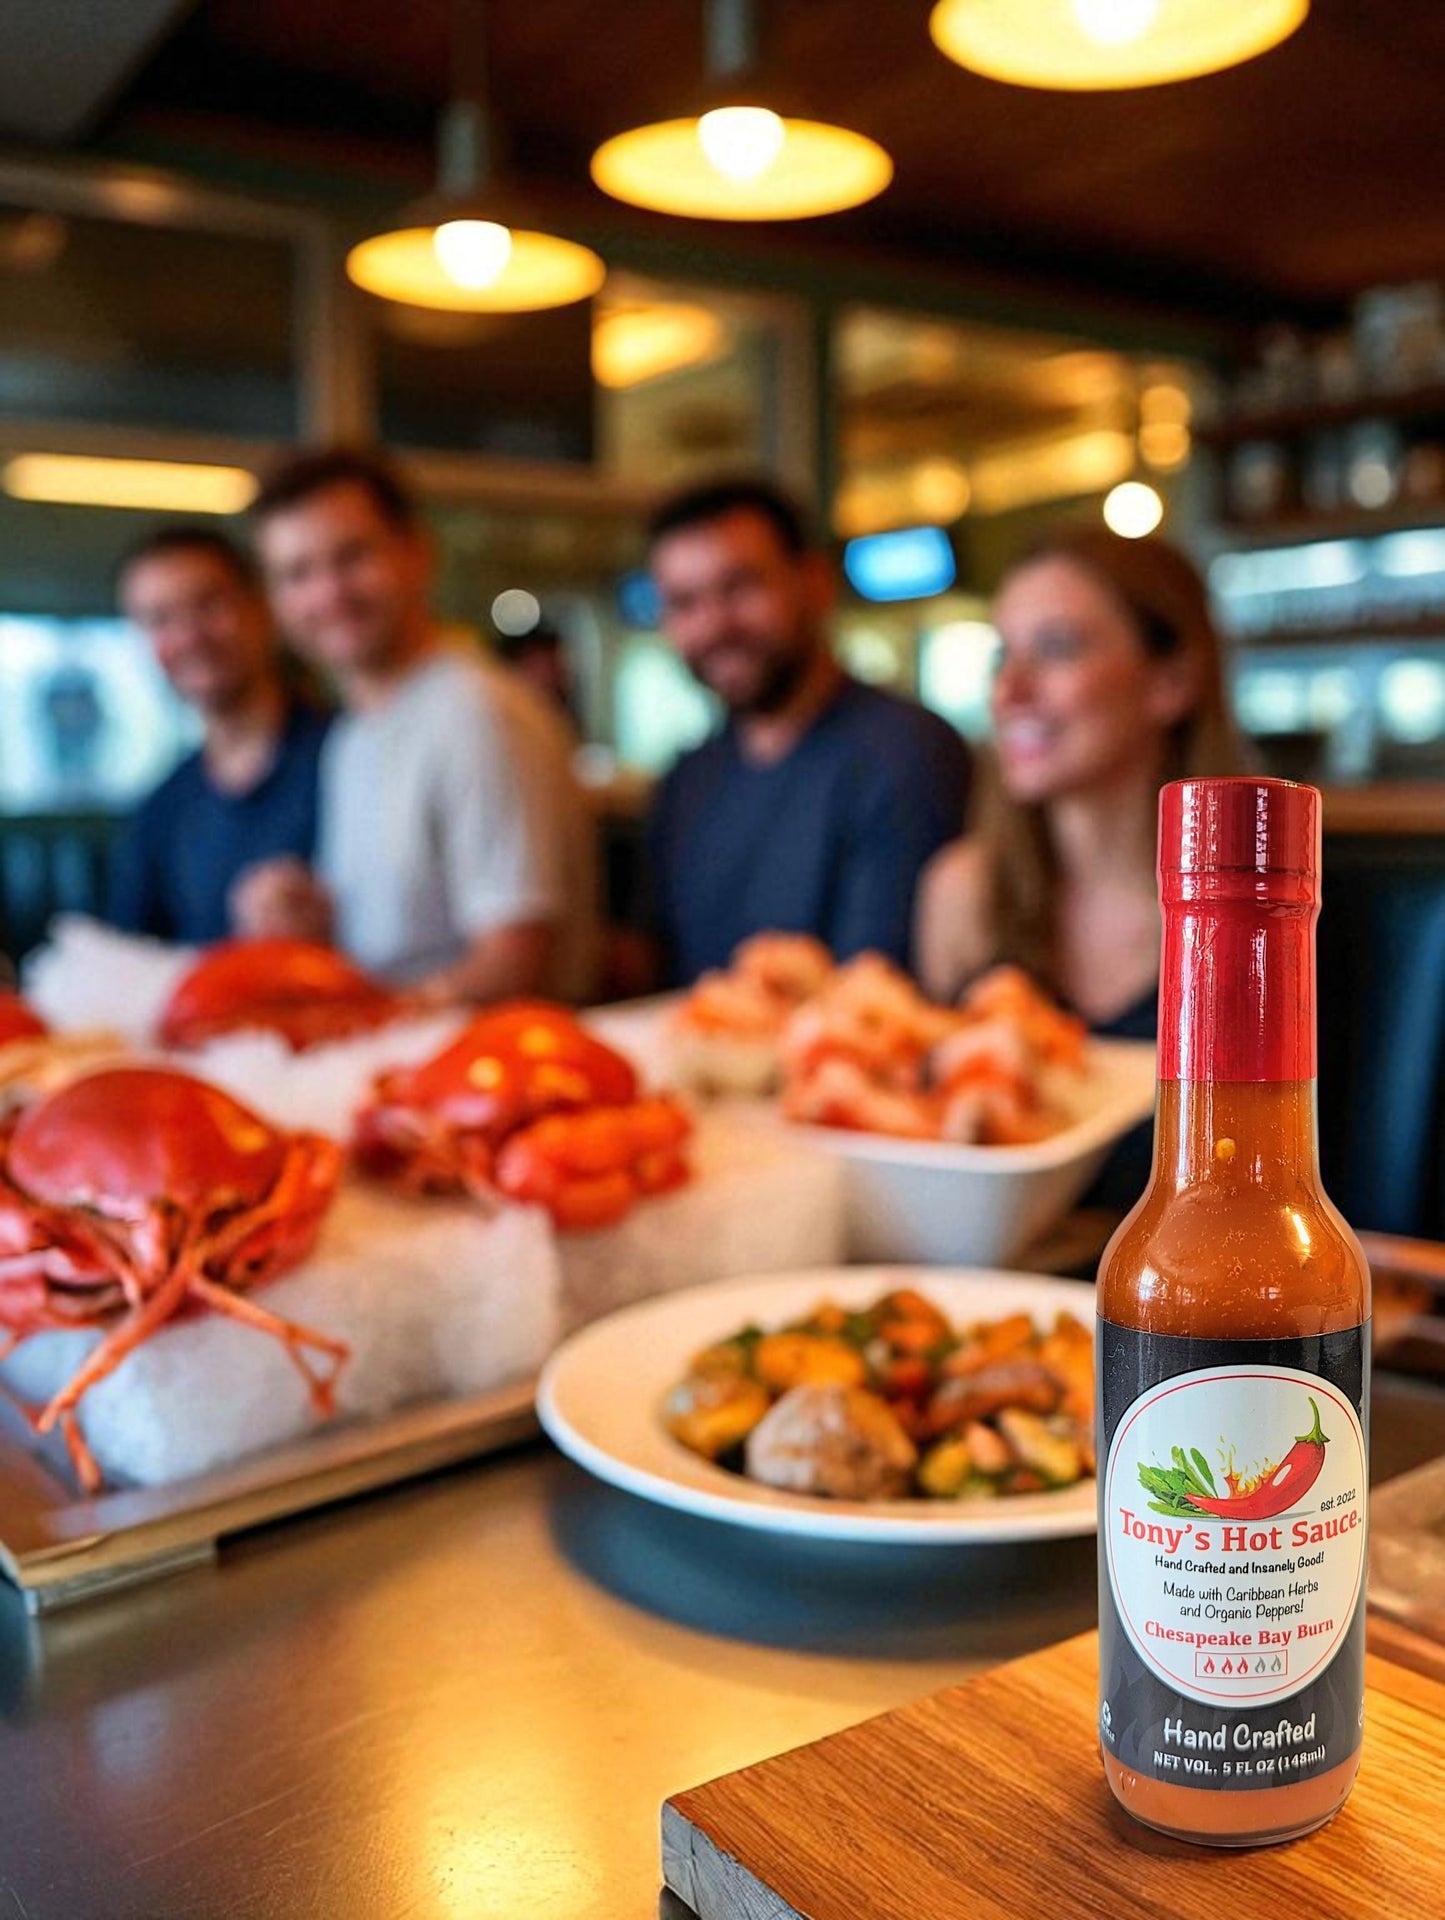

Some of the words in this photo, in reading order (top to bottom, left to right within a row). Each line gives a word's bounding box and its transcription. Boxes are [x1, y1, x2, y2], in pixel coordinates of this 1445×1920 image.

[1320, 1499, 1336, 1512] est.
[1336, 1489, 1356, 1507] 2022
[1221, 1526, 1283, 1552] Hot
[1292, 1509, 1357, 1547] Sauce
[1155, 1555, 1182, 1571] Hand
[1185, 1560, 1225, 1574] Crafted
[1229, 1562, 1248, 1574] and
[1252, 1559, 1295, 1574] Insanely
[1298, 1552, 1324, 1568] Good!
[1164, 1581, 1195, 1599] Made
[1199, 1587, 1222, 1601] with
[1226, 1587, 1285, 1602] Caribbean
[1288, 1580, 1318, 1597] Herbs
[1180, 1604, 1201, 1618] and
[1205, 1605, 1251, 1623] Organic
[1256, 1600, 1304, 1621] Peppers!
[1145, 1620, 1252, 1648] Chesapeake
[1258, 1629, 1292, 1647] Bay
[1297, 1619, 1334, 1639] Burn
[1164, 1717, 1226, 1751] Hand
[1233, 1713, 1317, 1751] Crafted
[1154, 1750, 1181, 1767] NET
[1183, 1757, 1217, 1774] VOL.
[1223, 1761, 1231, 1774] 5
[1236, 1761, 1253, 1772] FL
[1256, 1758, 1275, 1772] OZ
[1278, 1744, 1326, 1772] (148ml)
